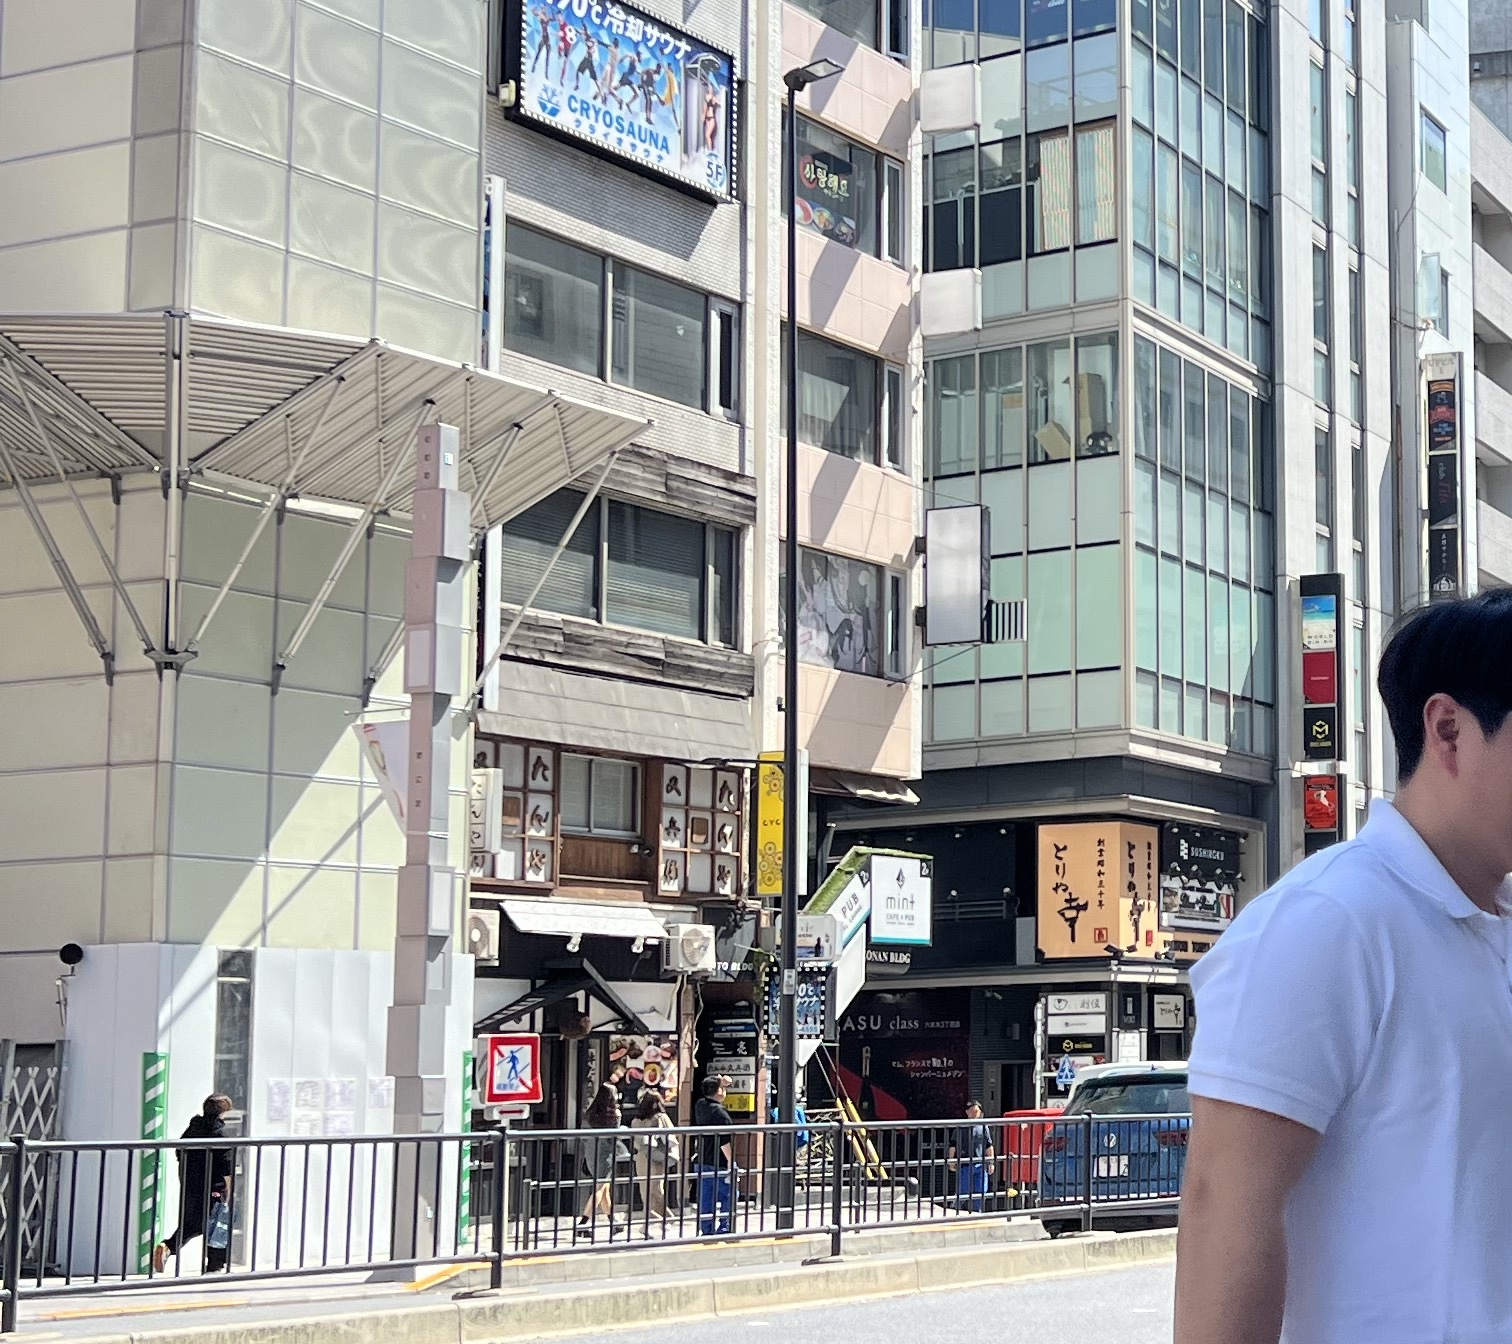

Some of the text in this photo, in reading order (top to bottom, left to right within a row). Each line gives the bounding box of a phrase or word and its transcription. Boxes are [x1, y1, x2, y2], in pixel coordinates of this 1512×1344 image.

[568, 94, 670, 155] CRYOSAUNA
[841, 892, 860, 919] PUB
[885, 893, 916, 911] mint
[889, 951, 911, 964] BLDG
[842, 1015, 882, 1032] ASU
[889, 1015, 920, 1030] class
